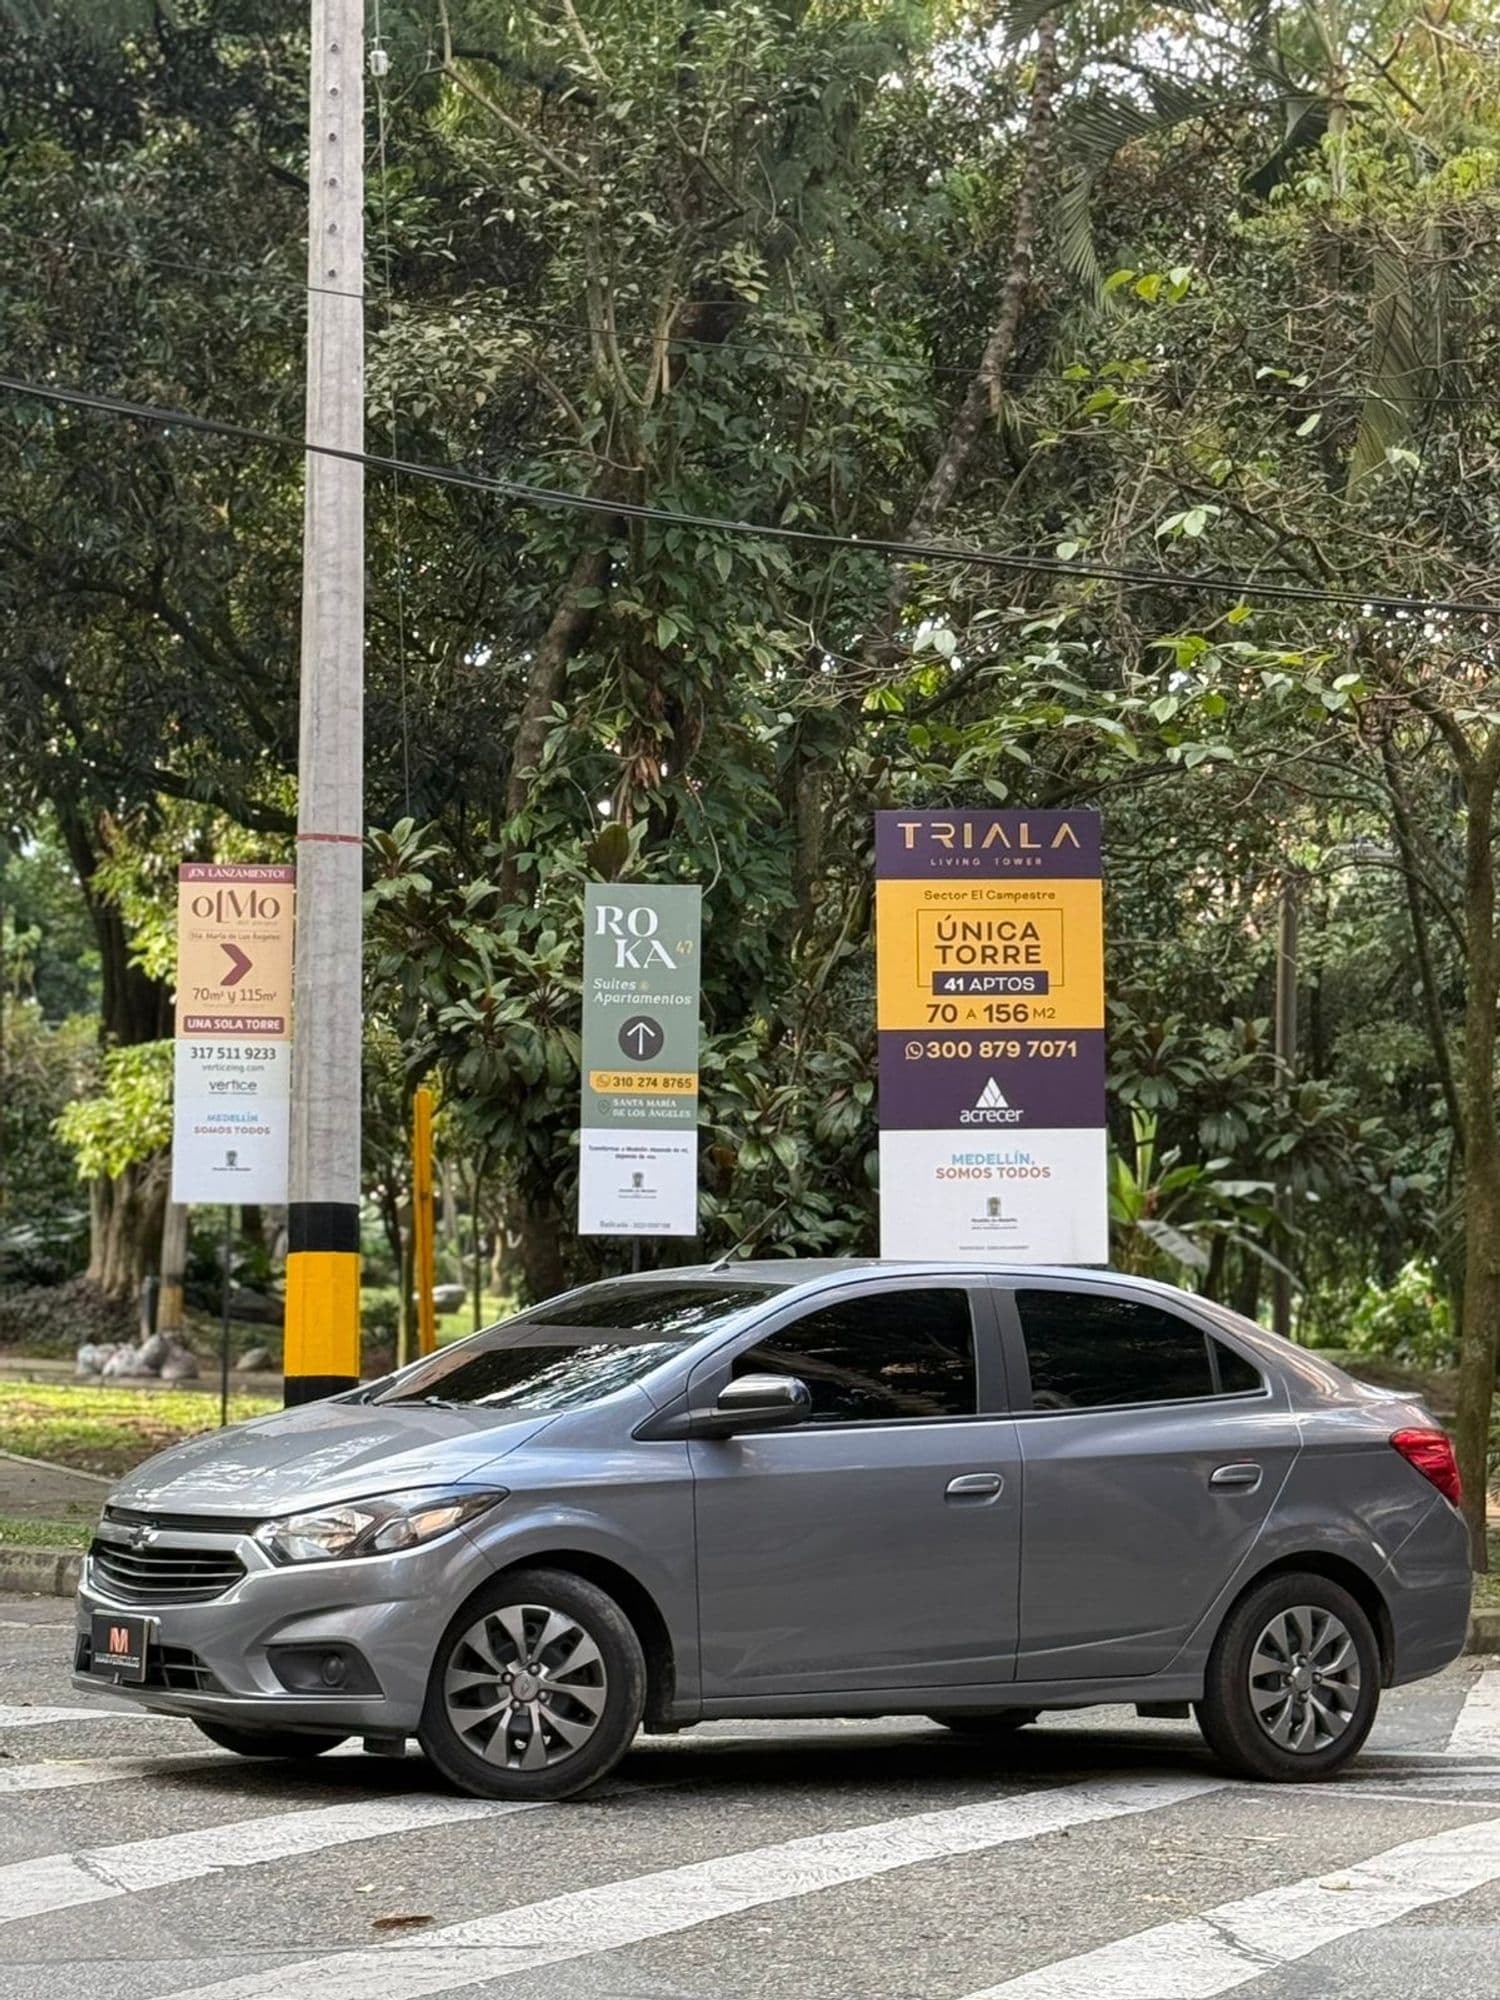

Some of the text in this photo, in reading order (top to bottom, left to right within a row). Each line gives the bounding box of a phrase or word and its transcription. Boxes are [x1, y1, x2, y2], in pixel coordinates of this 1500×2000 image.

[897, 822, 1081, 849] TRIALA
[930, 857, 1042, 866] LIVING TOWER
[924, 889, 1056, 903] Sector El Campestre
[595, 905, 658, 938] RO
[937, 914, 1040, 942] ÚNICA
[614, 939, 678, 970] KA
[934, 945, 1041, 965] TORRE
[592, 977, 637, 990] Suites
[944, 976, 1035, 991] 41 APTOS
[593, 991, 693, 1006] Apartamentos
[926, 1003, 1056, 1023] 70 A 156 M2
[187, 1018, 280, 1030] UNA SOLA TORRE
[191, 1047, 276, 1060] 317 511 9233
[926, 1040, 1078, 1059] 300 879 7071
[612, 1076, 693, 1089] 310 274 8765
[612, 1097, 677, 1108] SANTA MARÍA
[612, 1108, 626, 1117] DE
[627, 1108, 646, 1118] LOS
[959, 1109, 1025, 1123] acrecer
[193, 1126, 271, 1135] SOMOS TODOS
[936, 1166, 1051, 1180] SOMOS TODOS
